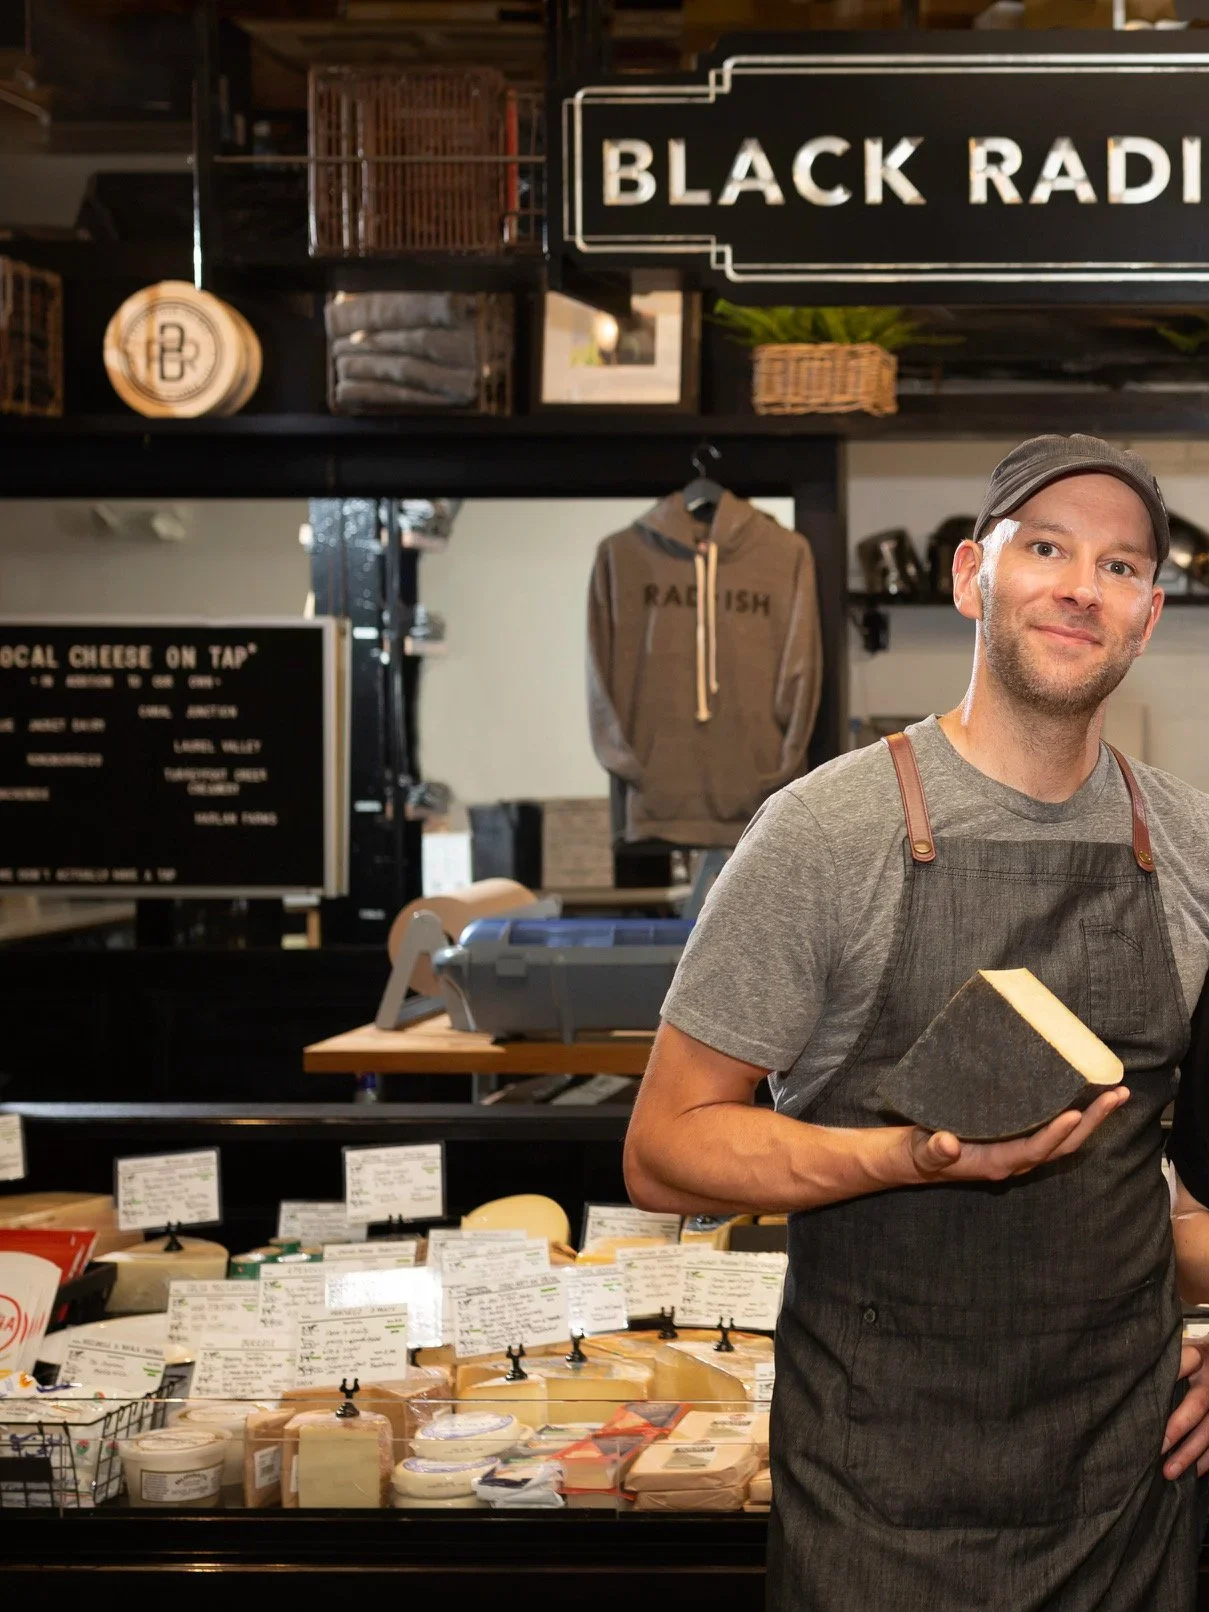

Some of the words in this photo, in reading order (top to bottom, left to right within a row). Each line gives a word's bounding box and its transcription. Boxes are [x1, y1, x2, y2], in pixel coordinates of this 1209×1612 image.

[602, 137, 925, 206] BLACK
[68, 645, 152, 669] CHEESE
[165, 645, 197, 669] ON
